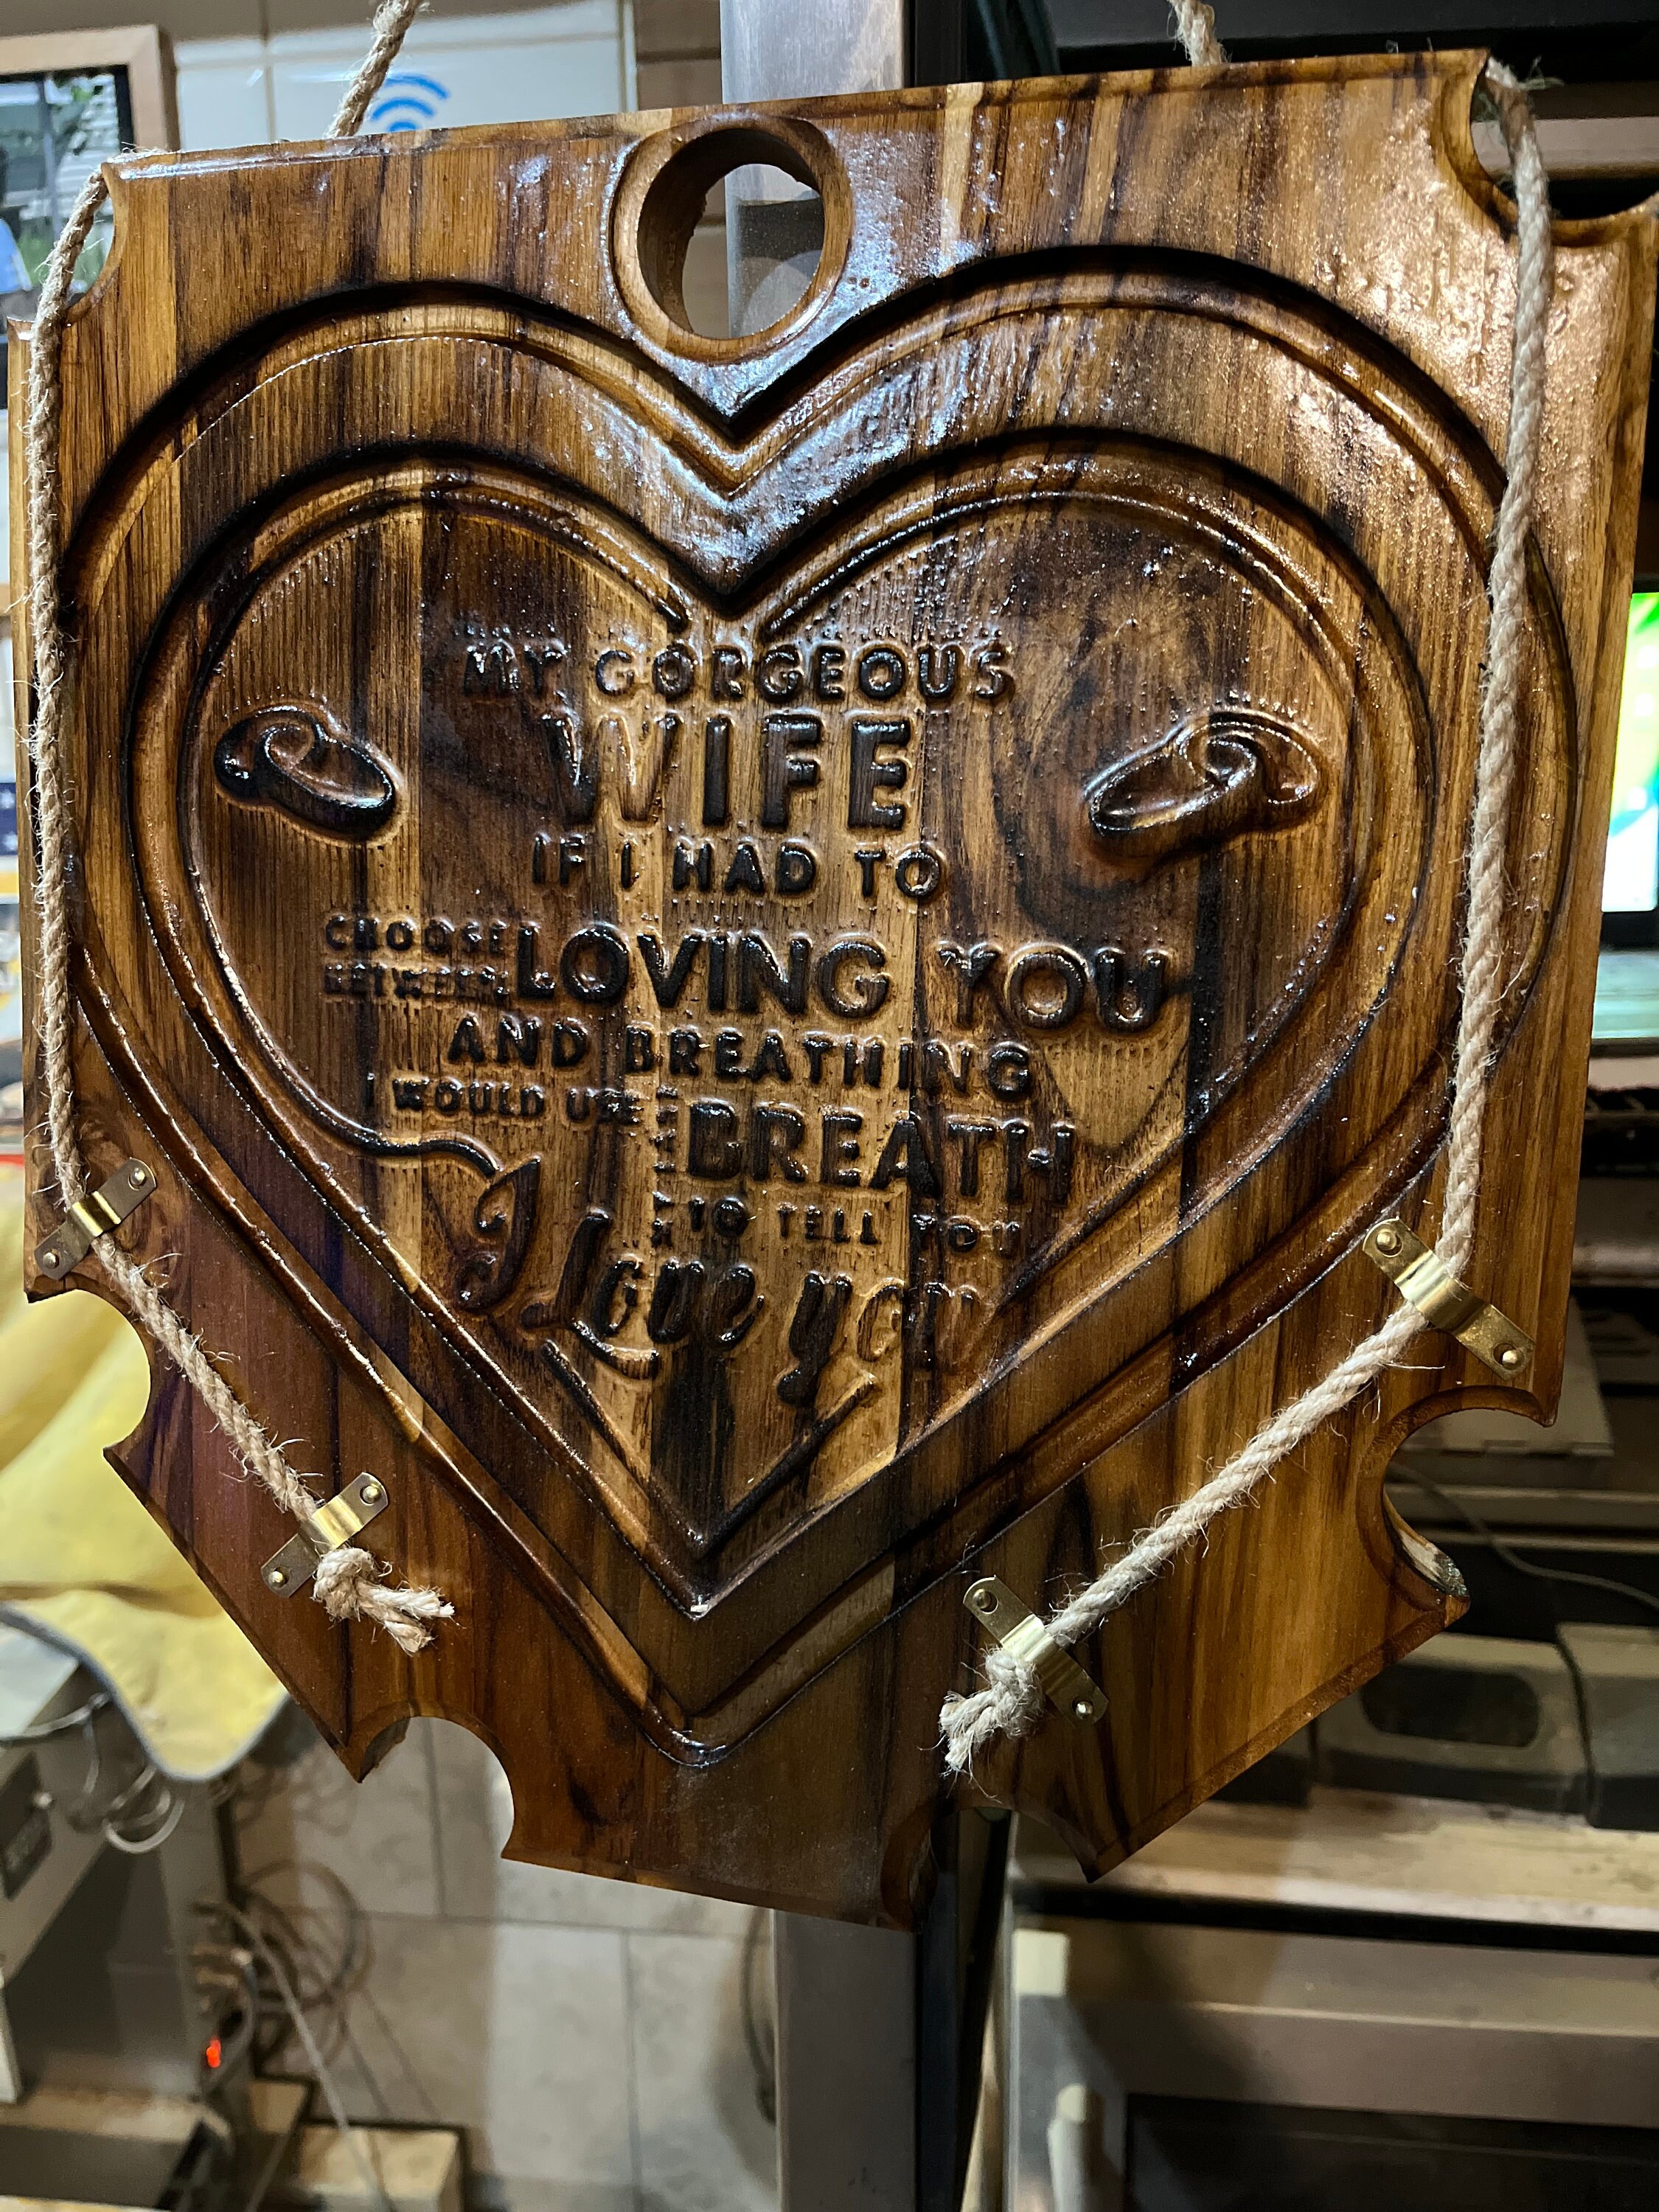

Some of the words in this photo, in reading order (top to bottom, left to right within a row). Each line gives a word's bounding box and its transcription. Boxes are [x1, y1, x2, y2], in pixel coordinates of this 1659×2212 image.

[462, 643, 568, 696] MY
[595, 641, 1013, 703] GORGEOUS
[540, 710, 913, 833] WIFE
[532, 832, 585, 887] IF
[619, 841, 633, 889] I
[671, 839, 818, 897] HAD
[854, 846, 946, 900] TO
[518, 923, 892, 1022] LOVING
[936, 945, 1174, 1034] YOU
[447, 1016, 588, 1069] AND
[625, 1022, 1031, 1102] BREATHING
[687, 1100, 1079, 1207] BREATH
[689, 1196, 752, 1240] TO
[776, 1200, 882, 1247] TELL
